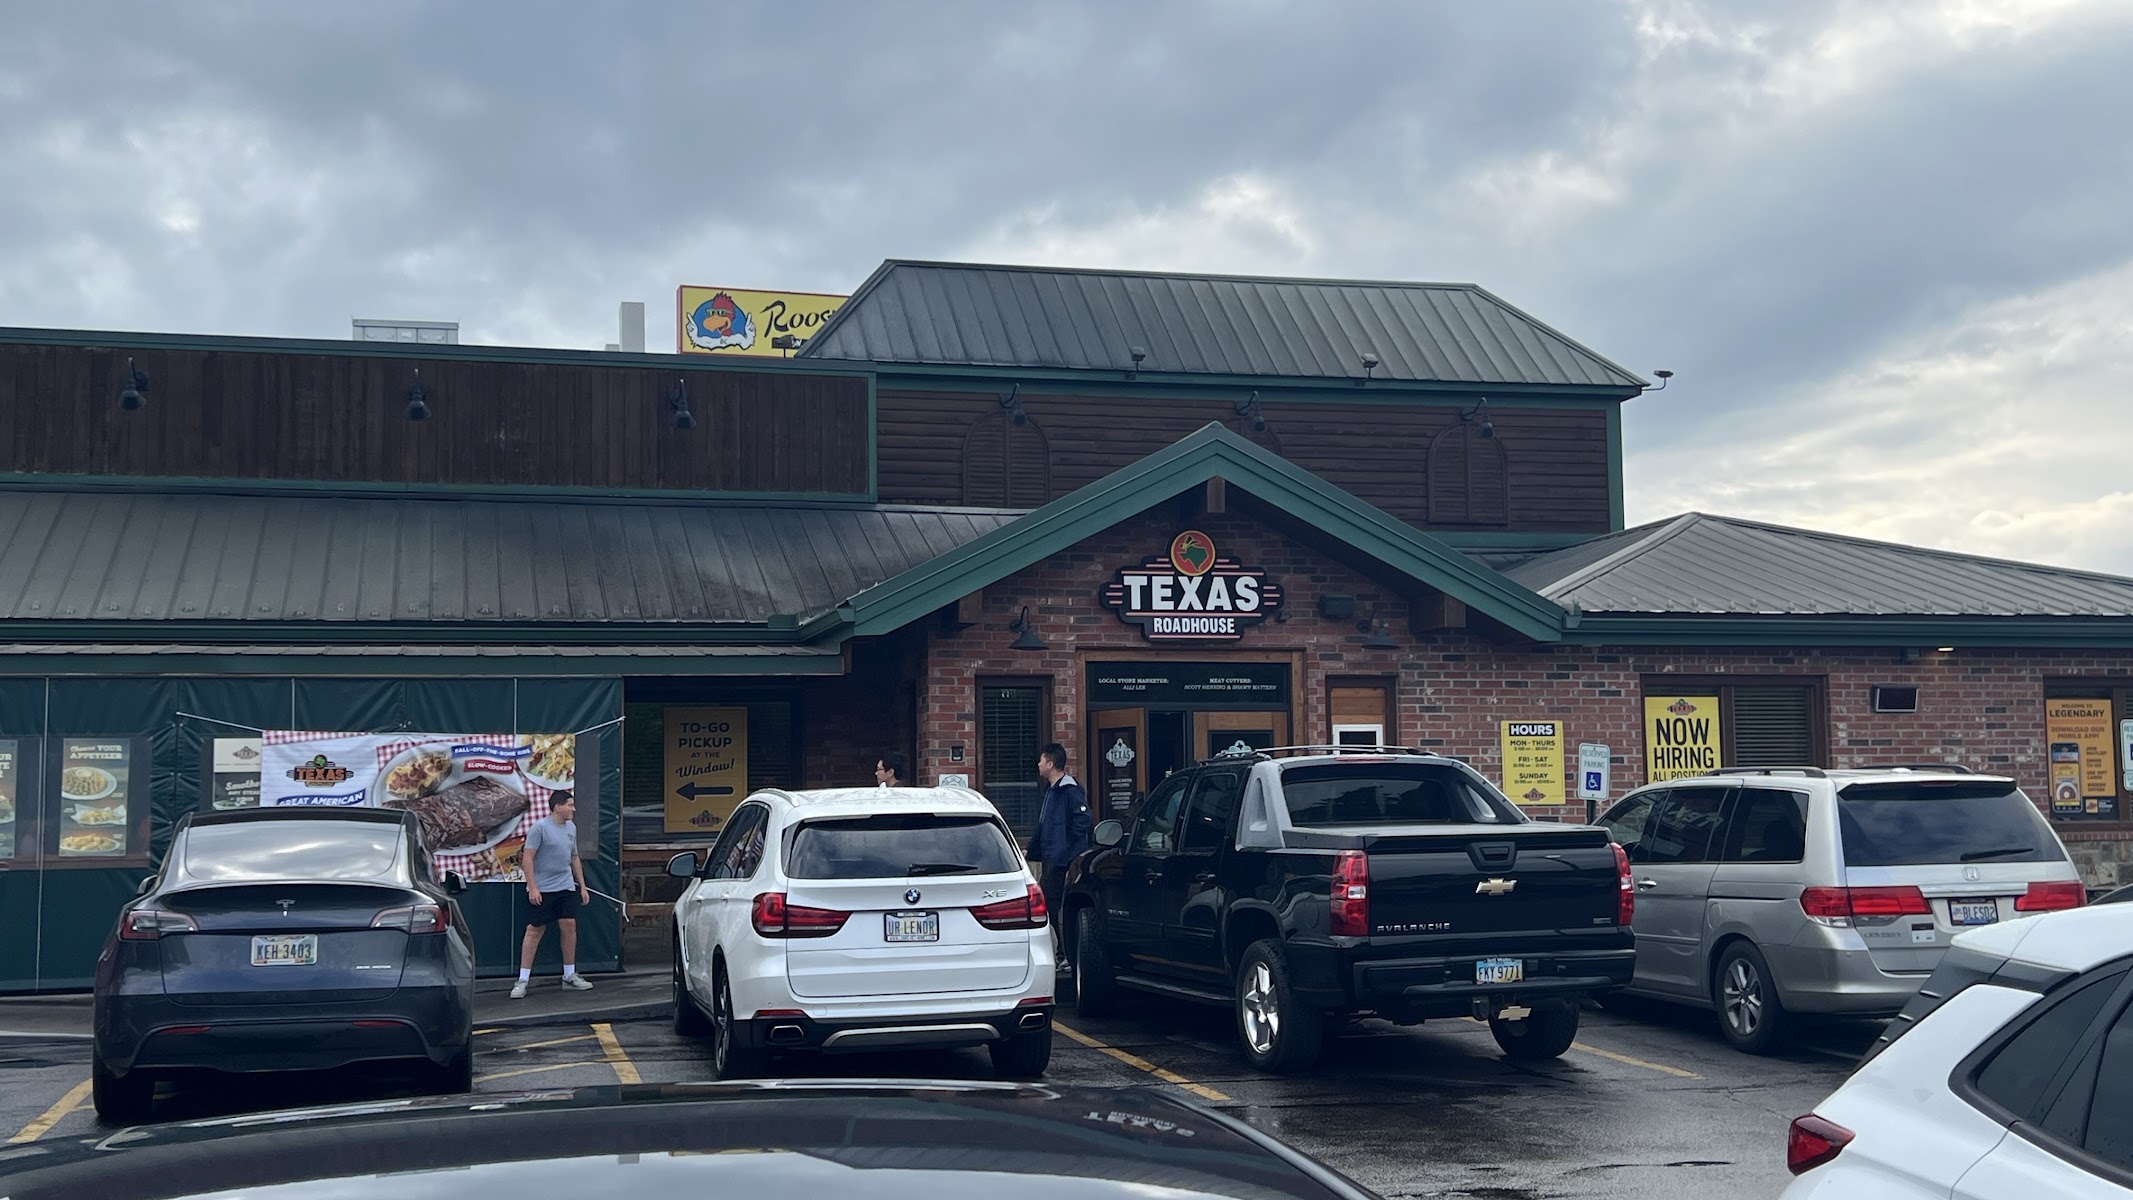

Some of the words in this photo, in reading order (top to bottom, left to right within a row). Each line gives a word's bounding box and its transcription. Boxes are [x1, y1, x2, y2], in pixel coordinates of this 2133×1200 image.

[760, 300, 835, 338] Roos
[1123, 575, 1260, 612] TEXAS
[1153, 617, 1235, 634] ROADHOUSE
[2049, 709, 2105, 718] LEGENDARY
[680, 722, 730, 733] TO-GO
[1510, 724, 1554, 736] HOURS
[1656, 717, 1710, 746] NOW
[96, 744, 122, 752] YOUR
[678, 737, 733, 749] PICKUP
[454, 746, 517, 757] FALL-OFF-THE-BONE
[1110, 749, 1131, 760] TEXAS
[1653, 747, 1715, 769] HIRING
[467, 762, 513, 771] SLOW-COOKED
[675, 758, 735, 778] Window!
[296, 768, 345, 780] TEXAS
[1653, 770, 1667, 782] ALL
[1671, 770, 1709, 780] POSITIO
[279, 797, 310, 806] GREAT
[310, 791, 364, 806] AMERICAN
[982, 889, 1008, 899] X5
[888, 920, 900, 935] UR
[1377, 922, 1451, 933] AVALANCHE
[257, 944, 279, 960] KEH
[282, 944, 312, 959] 3403
[1497, 965, 1520, 980] 9771
